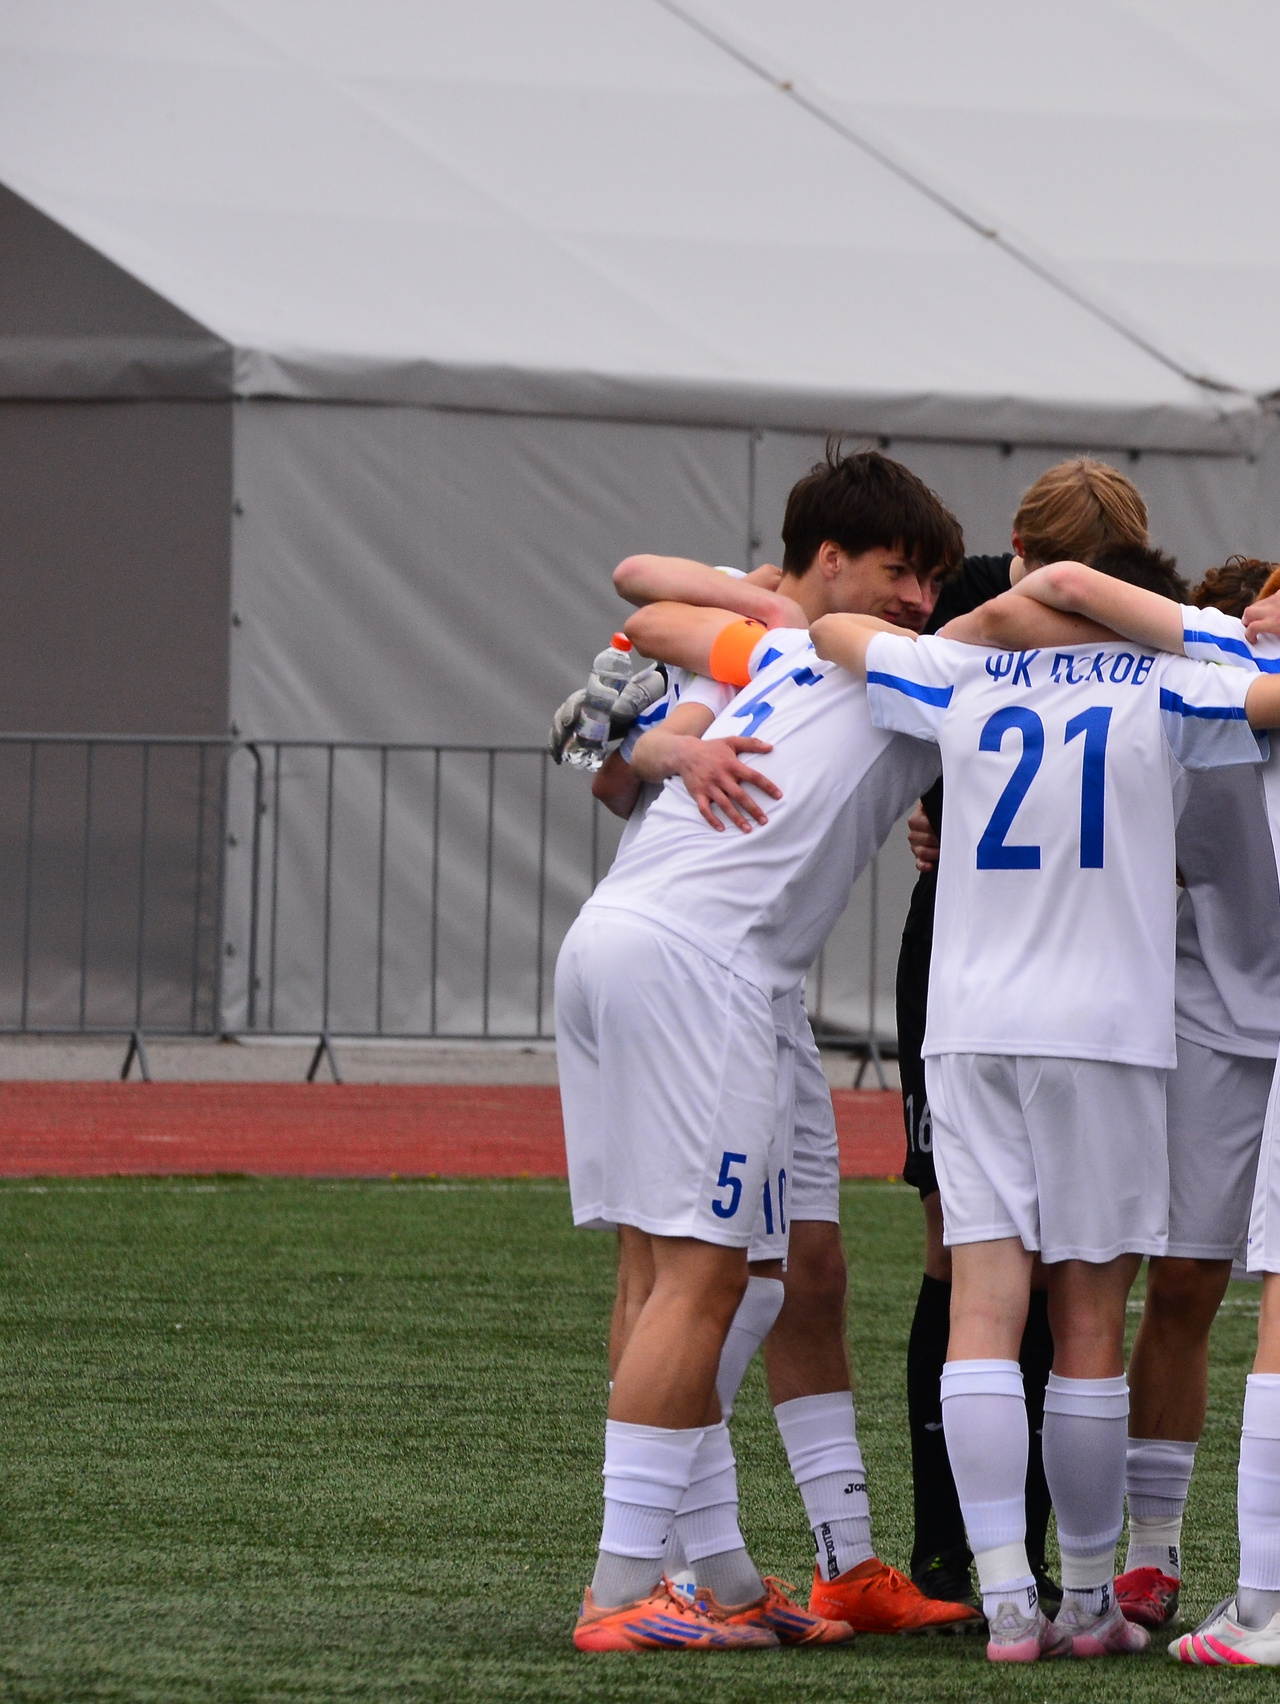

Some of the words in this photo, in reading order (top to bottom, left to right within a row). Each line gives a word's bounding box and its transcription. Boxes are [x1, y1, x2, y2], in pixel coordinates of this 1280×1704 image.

[985, 650, 1041, 688] ФК
[1050, 652, 1156, 685] ПСКОВ
[976, 705, 1113, 870] 21
[906, 1093, 933, 1153] 16
[711, 1151, 747, 1219] 5
